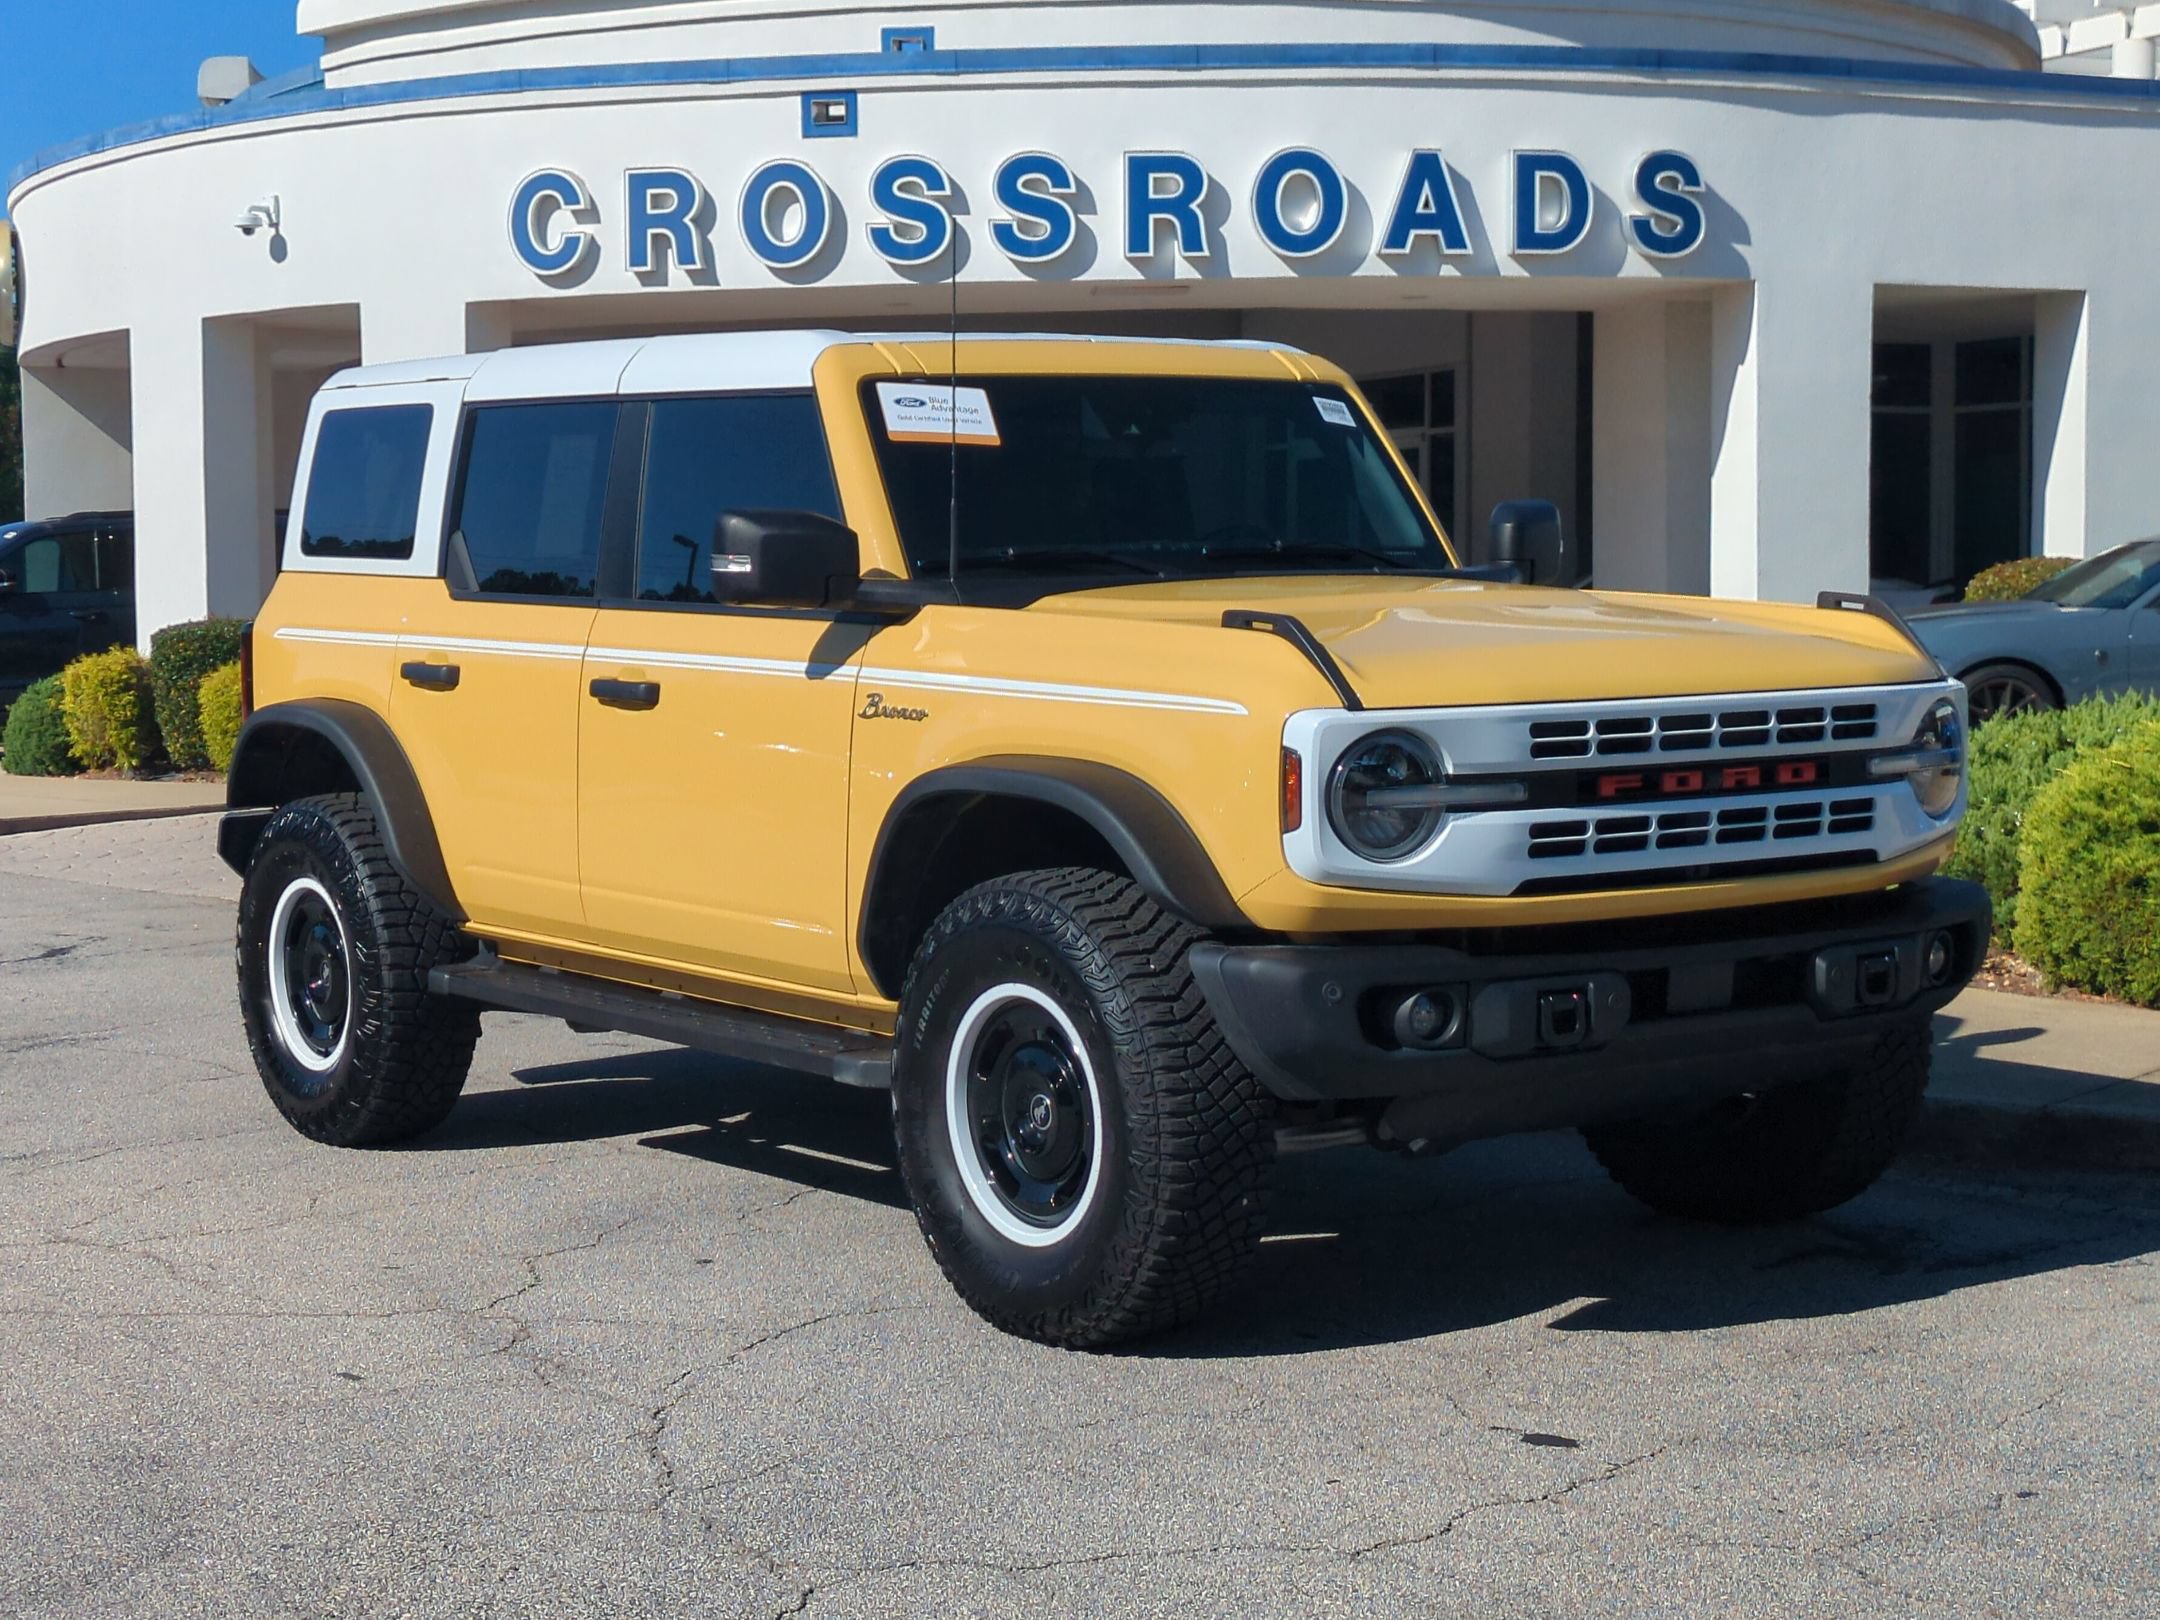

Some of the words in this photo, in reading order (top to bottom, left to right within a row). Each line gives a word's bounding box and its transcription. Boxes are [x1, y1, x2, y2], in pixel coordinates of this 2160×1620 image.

[508, 146, 1706, 276] CROSSROADS
[857, 692, 929, 722] Bronco
[1597, 762, 1817, 798] FORD
